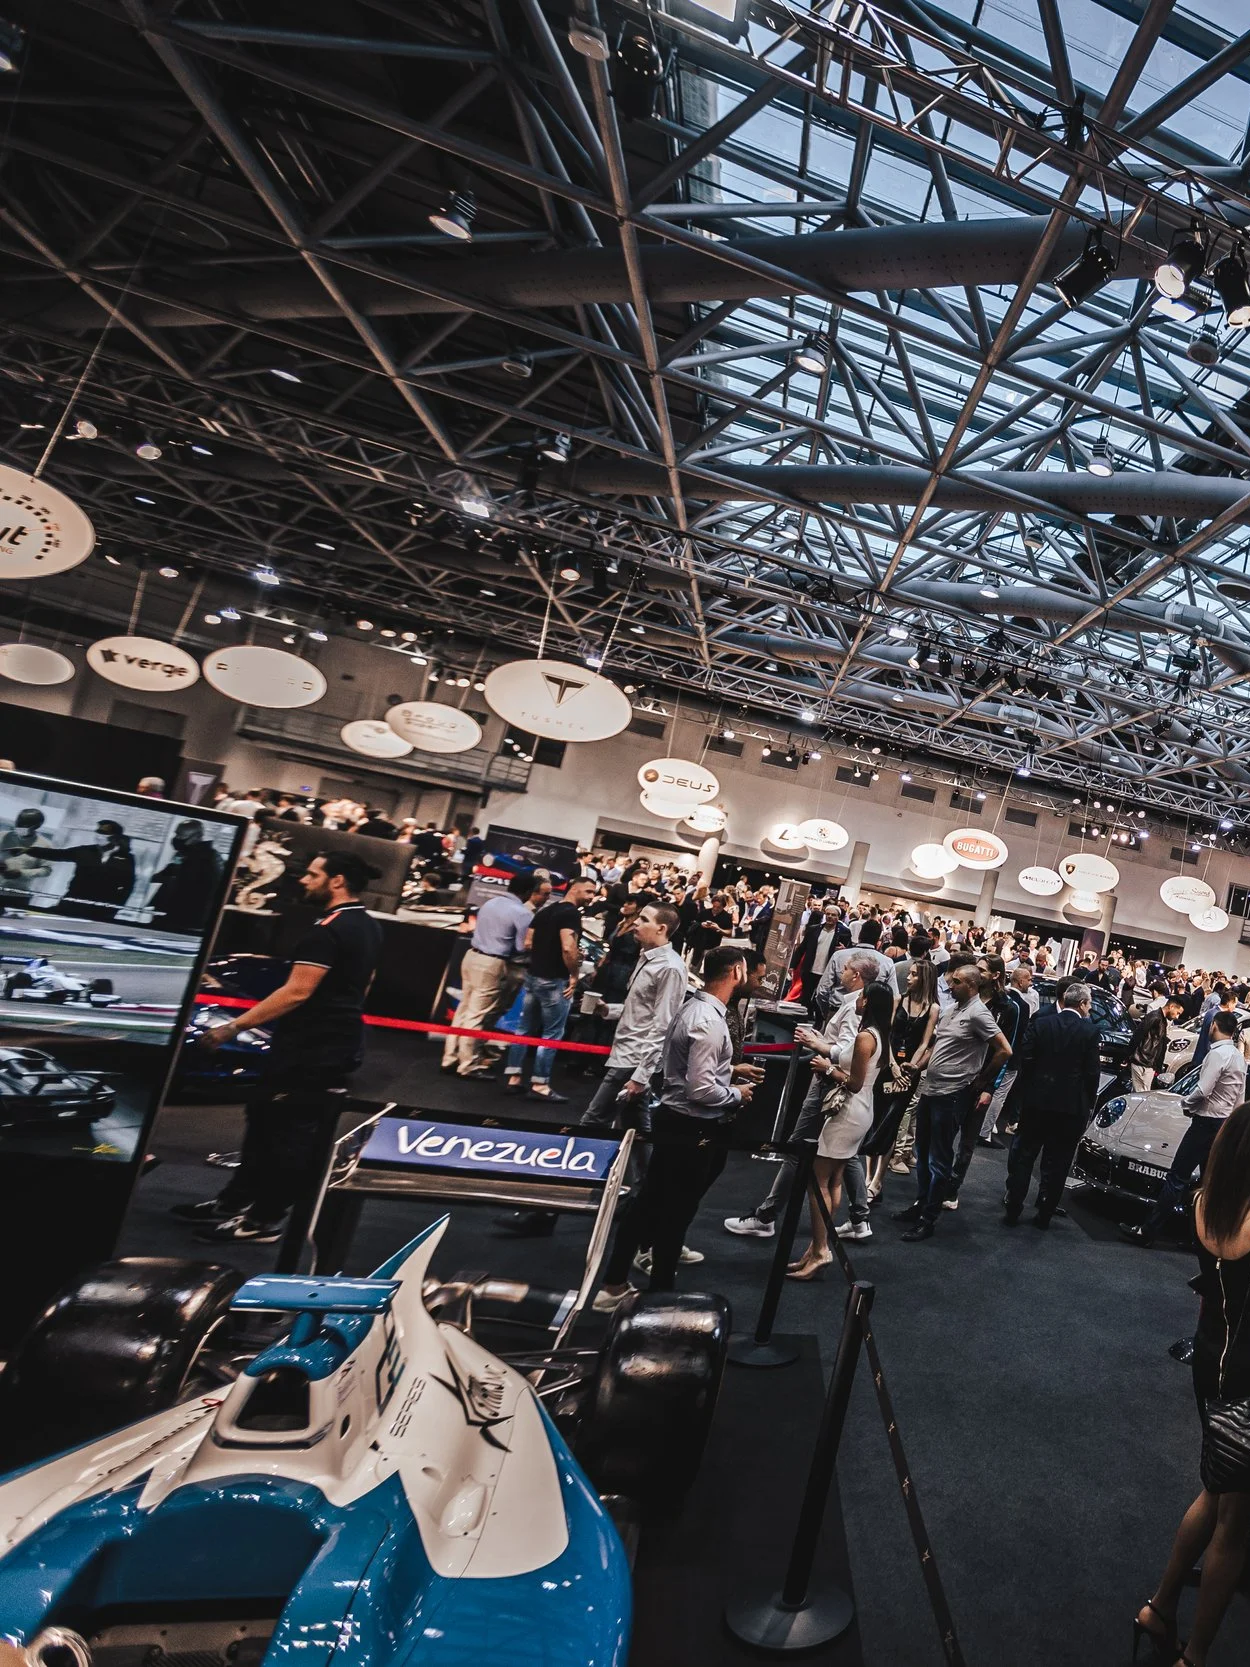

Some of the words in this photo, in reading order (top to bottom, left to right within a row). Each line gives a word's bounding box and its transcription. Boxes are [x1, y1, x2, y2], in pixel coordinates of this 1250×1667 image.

[124, 654, 189, 678] verge
[661, 774, 716, 793] DEUS
[956, 841, 995, 858] BUGATTI
[397, 1125, 597, 1174] Venezuela
